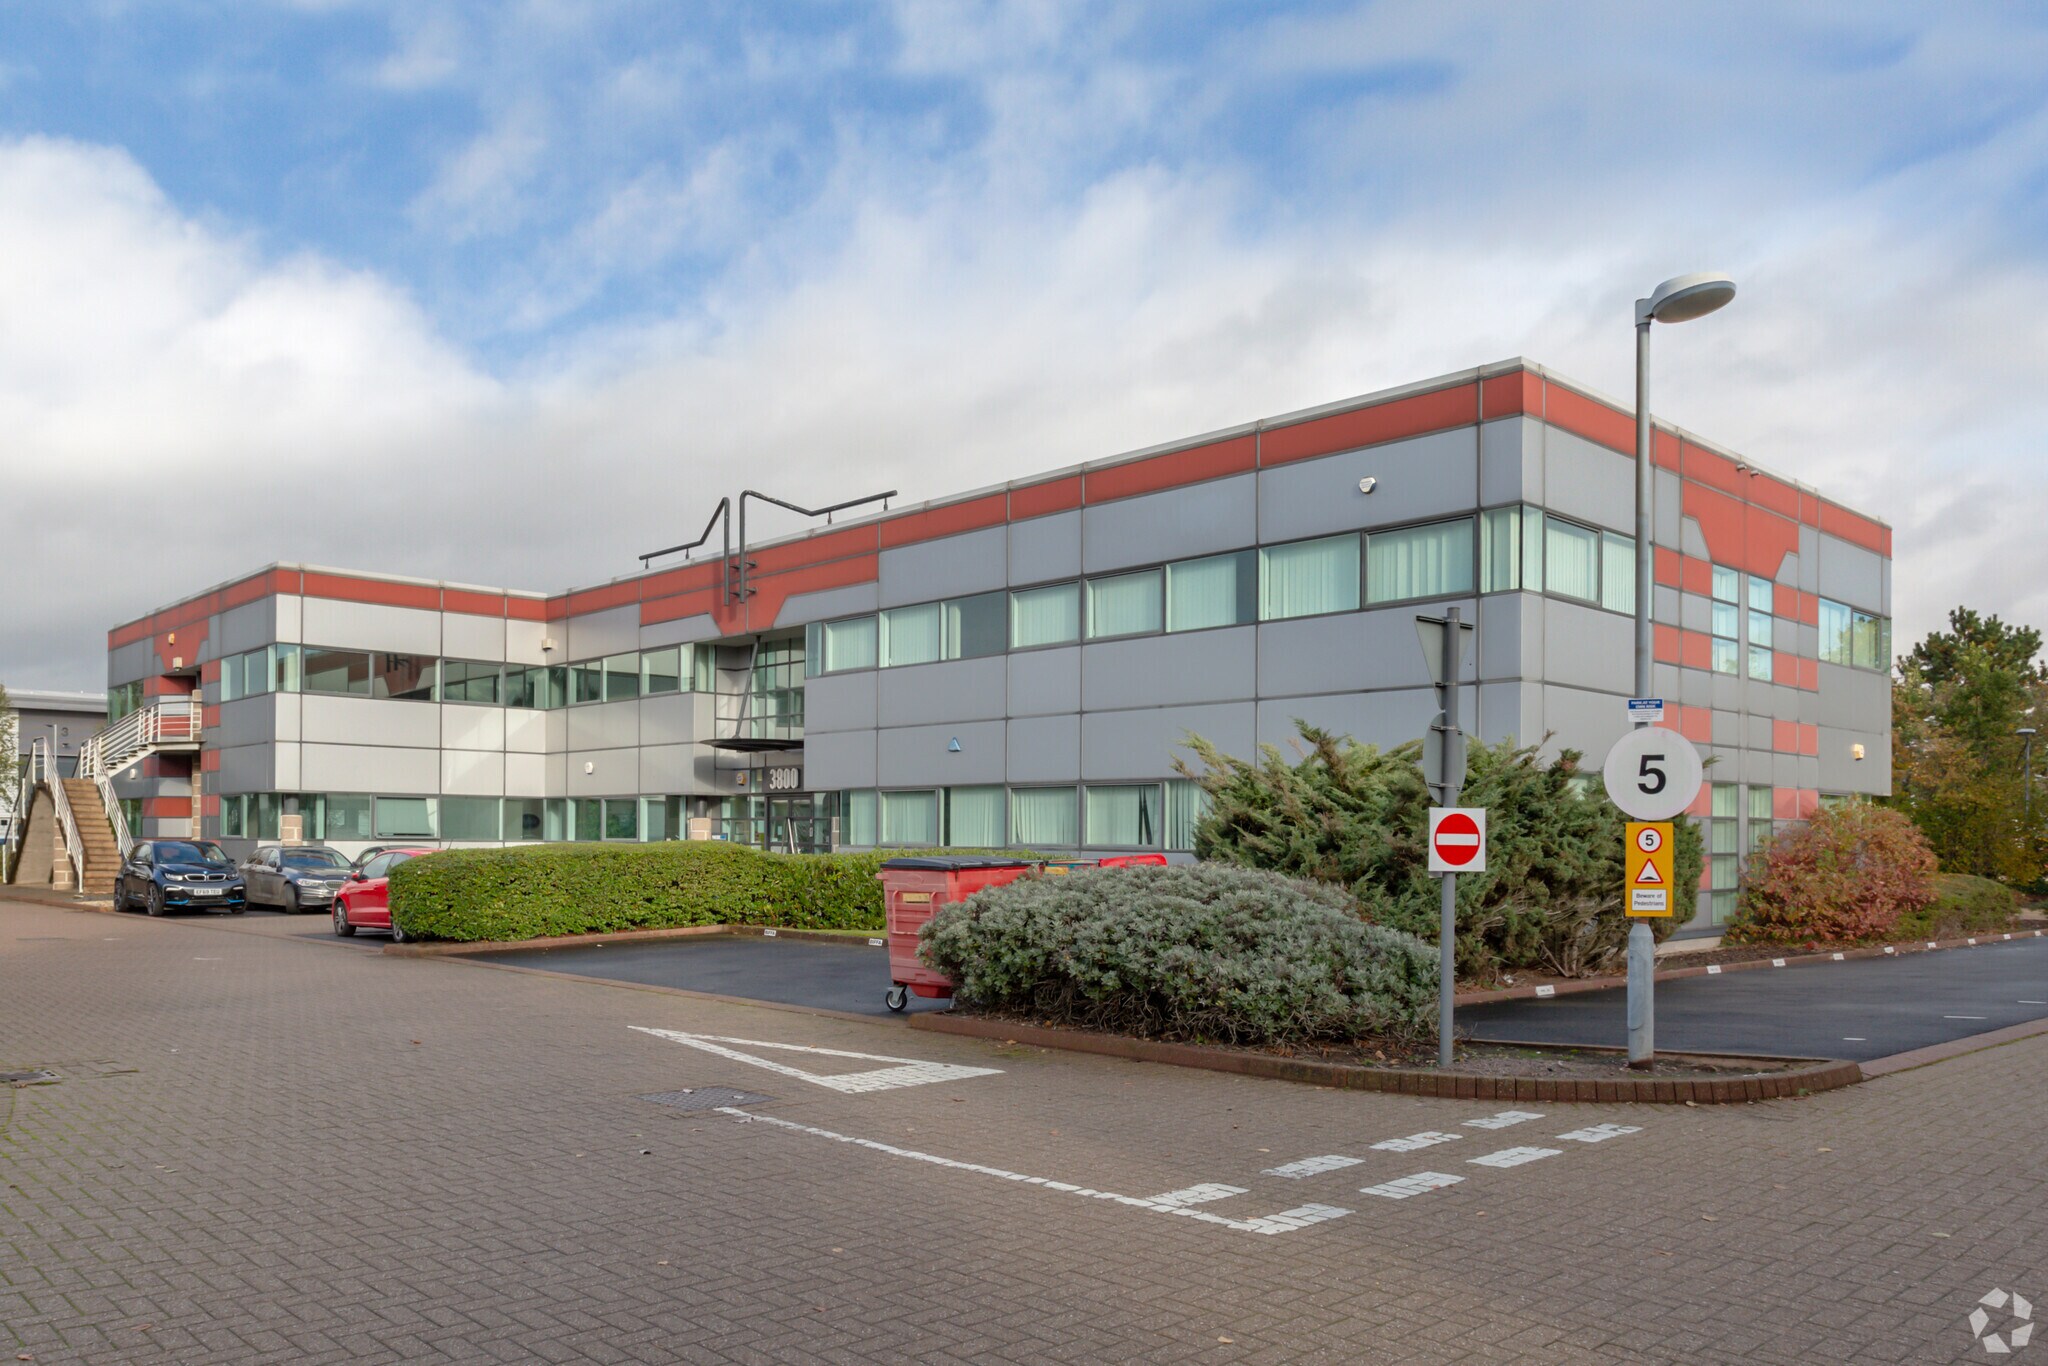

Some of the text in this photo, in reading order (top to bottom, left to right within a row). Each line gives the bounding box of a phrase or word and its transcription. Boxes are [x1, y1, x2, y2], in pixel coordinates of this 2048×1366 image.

[61, 727, 69, 737] 3
[769, 767, 799, 789] 3800
[1638, 754, 1667, 795] 5
[1645, 834, 1654, 847] 5
